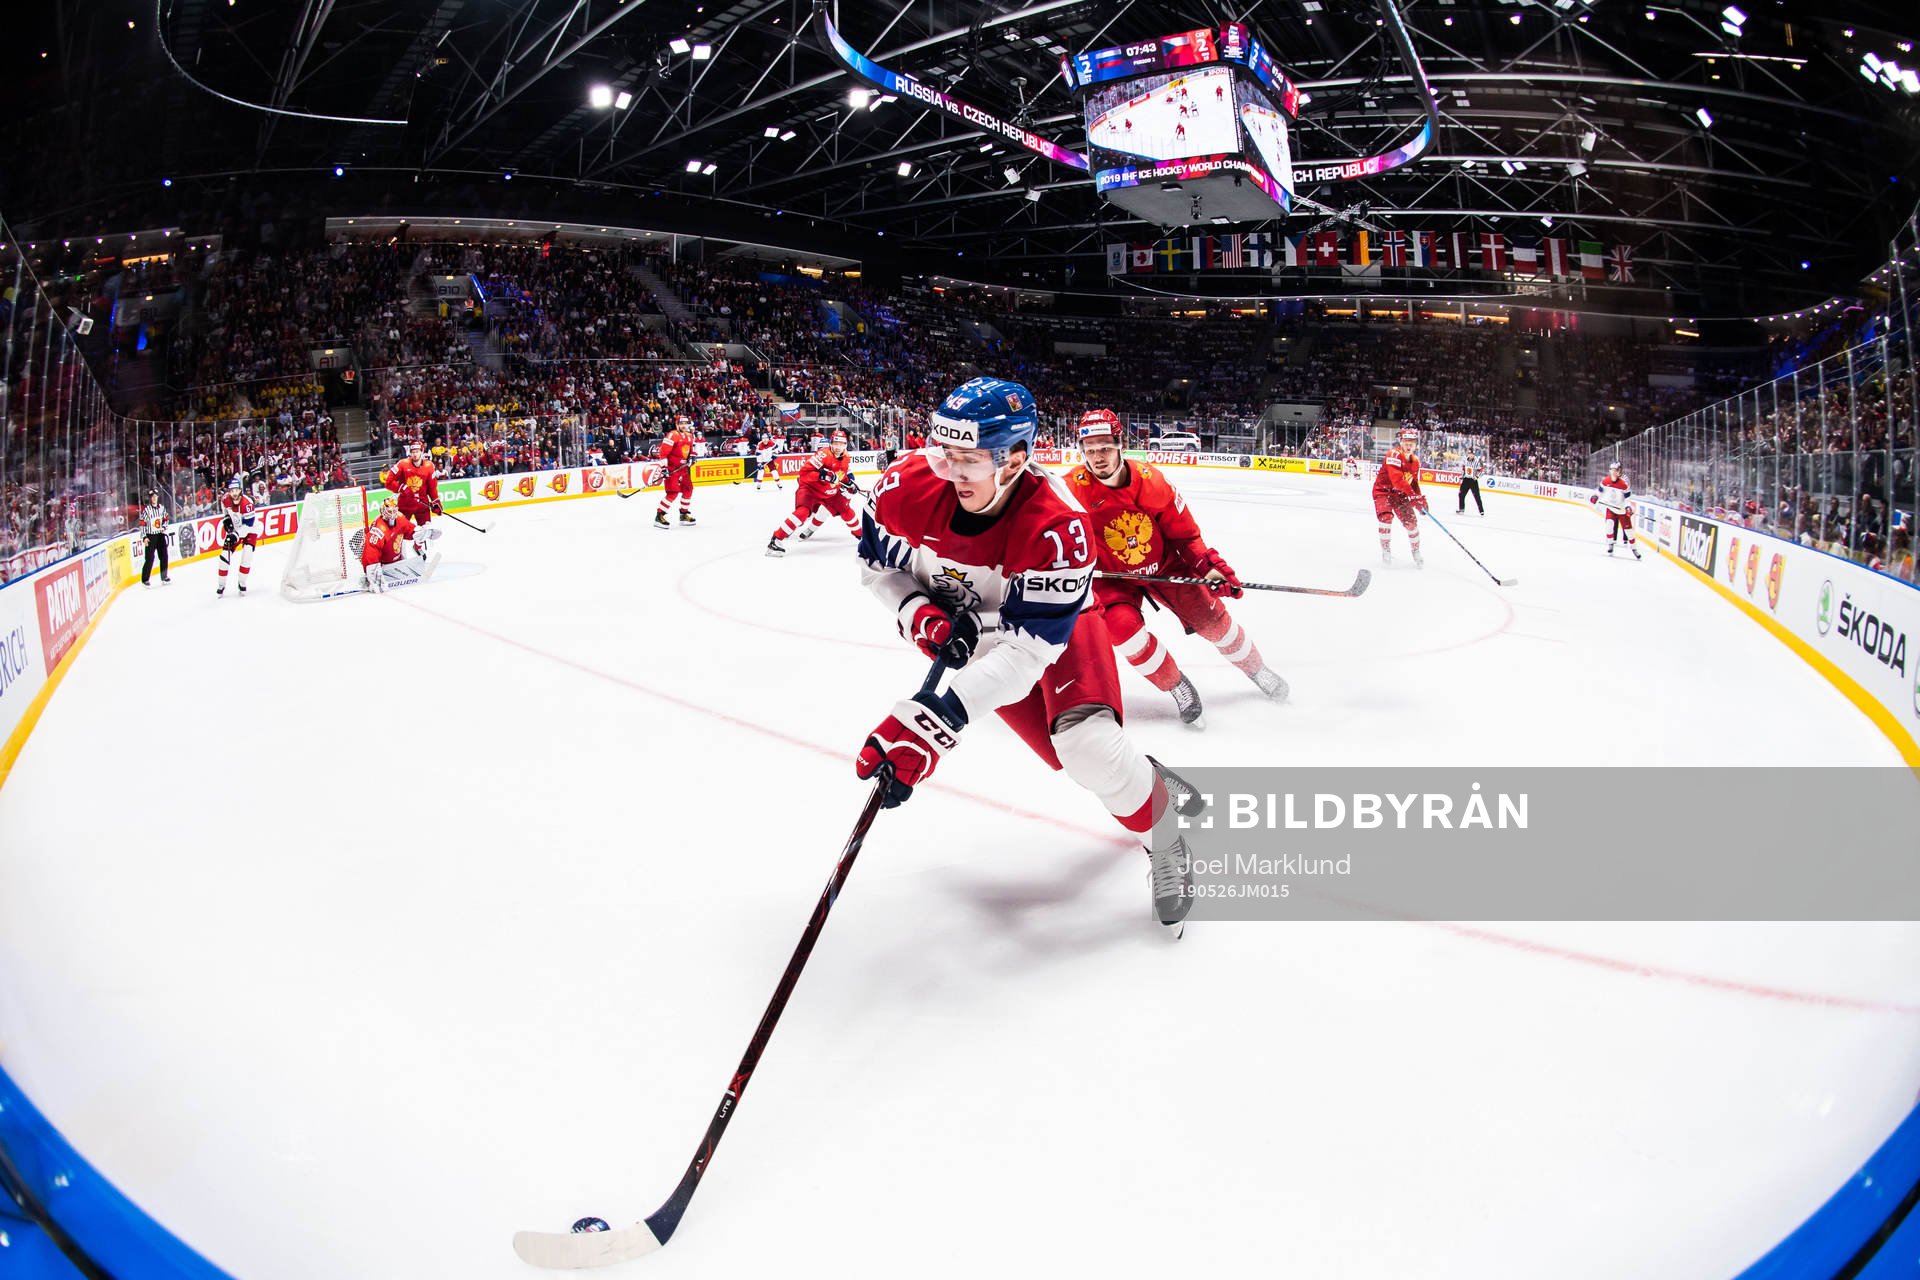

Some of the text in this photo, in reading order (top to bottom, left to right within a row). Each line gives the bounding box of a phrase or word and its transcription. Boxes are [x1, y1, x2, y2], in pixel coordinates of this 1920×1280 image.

[1126, 43, 1157, 57] 07:43
[1196, 39, 1208, 52] 2
[1081, 61, 1093, 74] 2
[895, 75, 1055, 155] RUSSIA vs. CZECH REPUBLIC
[1100, 174, 1121, 185] 2019
[1121, 171, 1138, 182] IIHF
[1138, 168, 1151, 179] ICE
[1152, 164, 1188, 178] HOCKEY
[1189, 160, 1222, 173] WORLD
[1315, 160, 1378, 182] REPUBLIC
[932, 424, 975, 442] KODA
[1032, 453, 1061, 462] ATE-M.RU
[1146, 452, 1197, 465] ФОНБЕТ
[1208, 455, 1238, 463] TISSOT
[695, 463, 740, 479] PIRELLI
[1435, 473, 1459, 483] KRUŠO
[1539, 485, 1558, 498] IIHF
[245, 503, 254, 513] 67
[198, 508, 297, 551] ФОБЕТ
[1043, 518, 1089, 569] 13
[45, 570, 81, 636] PATRON
[1837, 592, 1907, 678] ŠKODA
